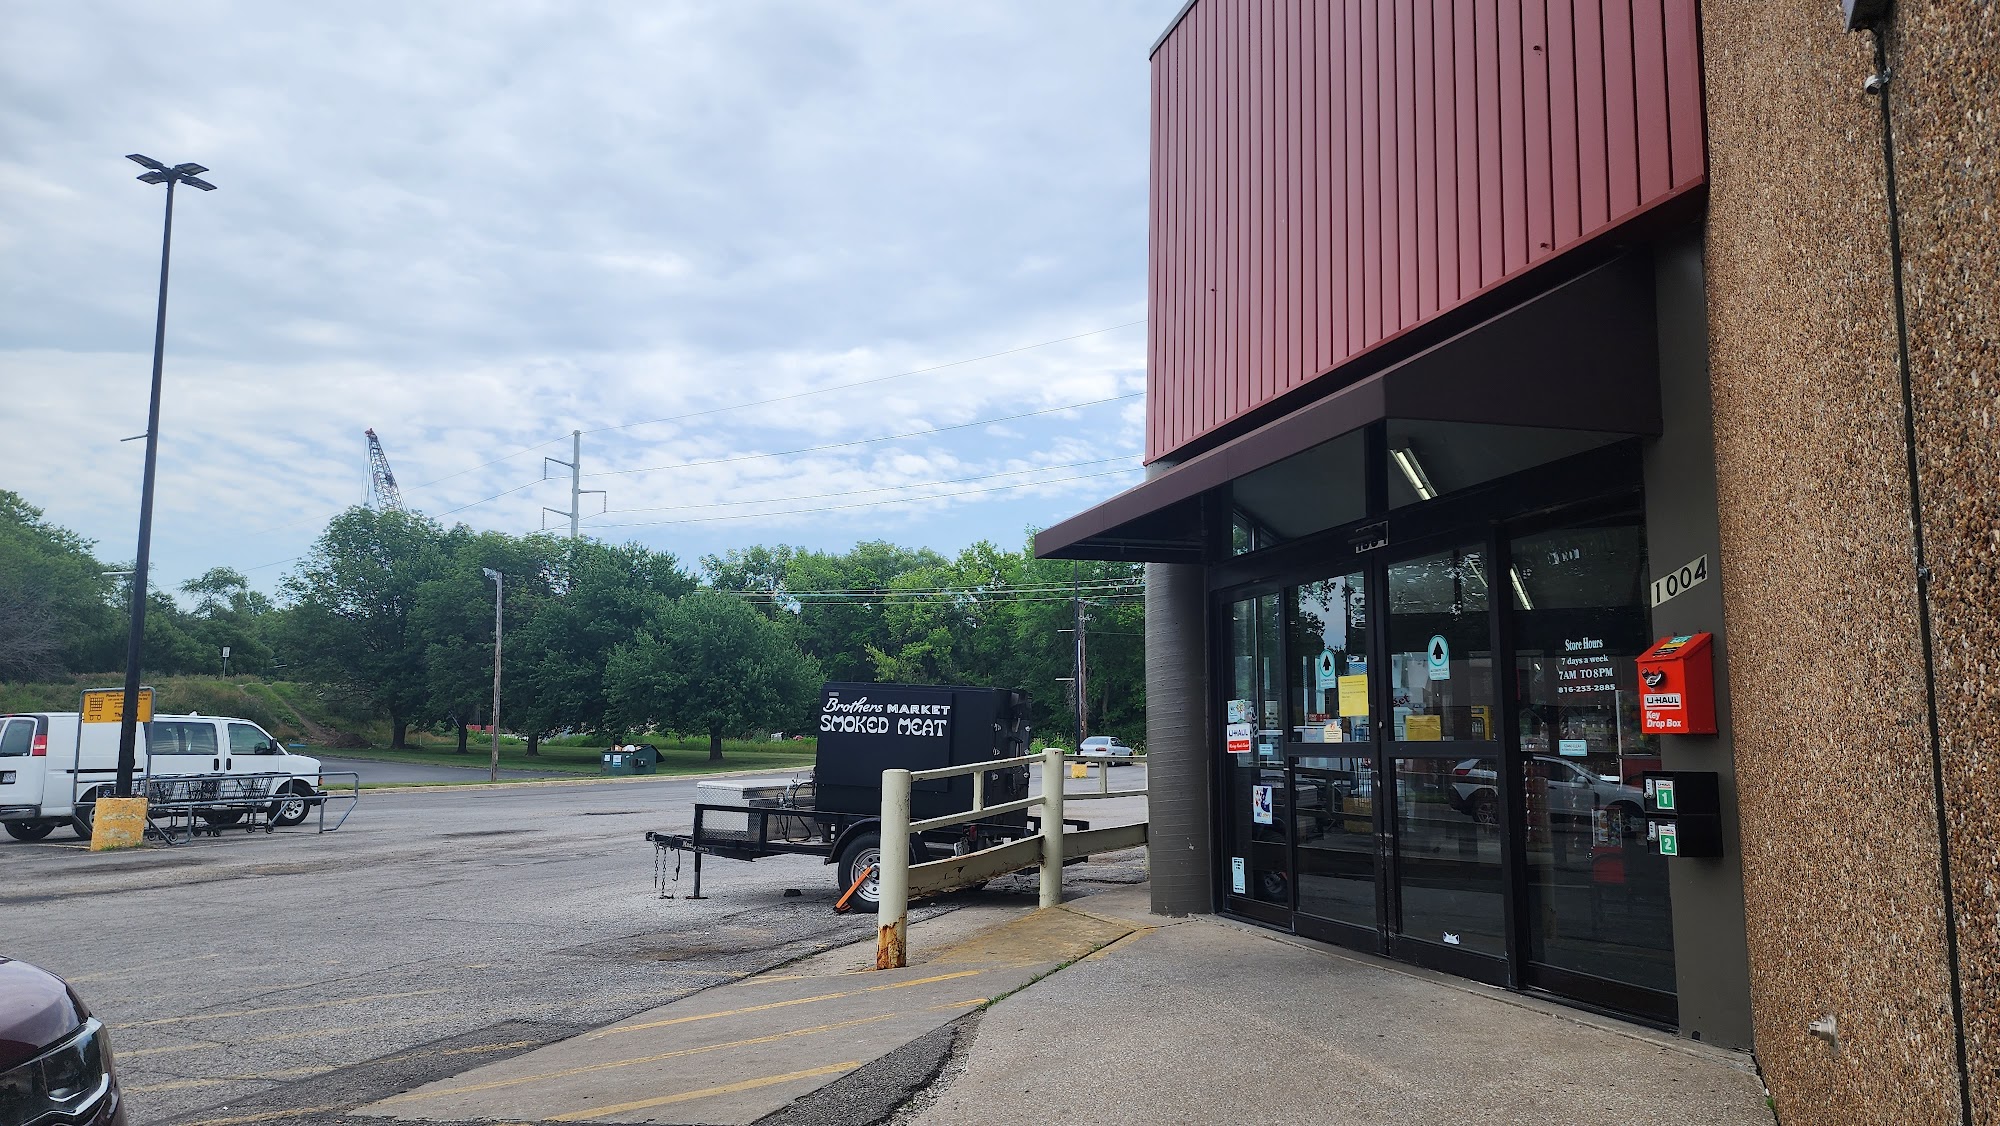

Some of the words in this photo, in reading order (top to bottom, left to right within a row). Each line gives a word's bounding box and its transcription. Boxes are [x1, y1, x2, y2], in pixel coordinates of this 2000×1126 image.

[1656, 556, 1707, 603] 1004
[1565, 638, 1583, 652] Store
[1583, 636, 1604, 650] Hours
[1561, 657, 1567, 666] 7
[1567, 656, 1583, 667] days
[1590, 654, 1610, 664] week
[1559, 670, 1578, 681] 7AM
[1646, 695, 1680, 704] U-HAUL
[823, 697, 884, 714] Brothers
[887, 703, 951, 716] MARKET
[1646, 710, 1661, 721] Key
[820, 714, 890, 734] SMOKED
[898, 718, 947, 736] MEAT
[1647, 719, 1666, 730] Drop
[1666, 718, 1682, 728] Box
[1661, 792, 1668, 805] 1
[1664, 837, 1672, 851] 2
